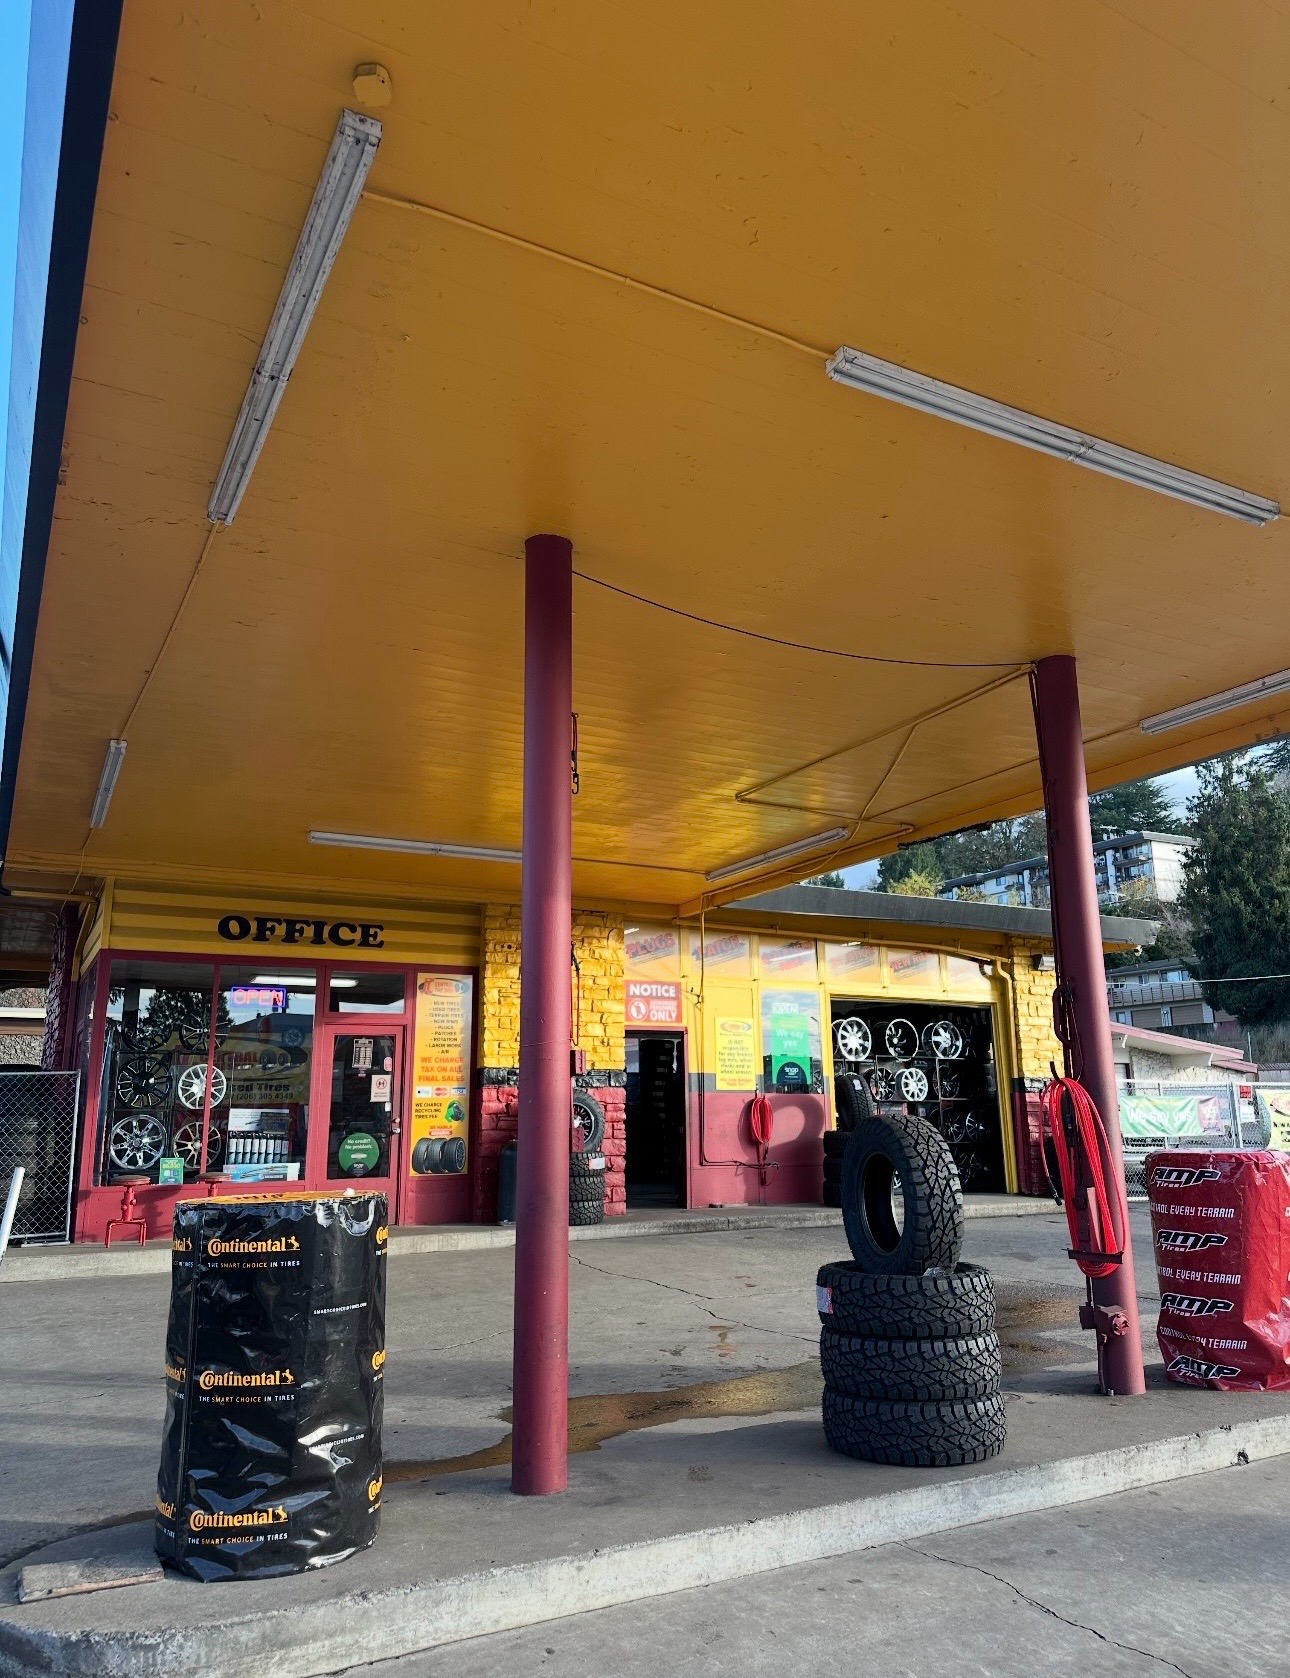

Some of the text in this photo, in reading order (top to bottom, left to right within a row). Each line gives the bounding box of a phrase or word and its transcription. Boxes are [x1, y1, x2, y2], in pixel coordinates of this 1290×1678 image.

[217, 915, 385, 948] OFFICE
[625, 932, 676, 960] PLUGS
[629, 983, 676, 997] NOTICE
[234, 989, 283, 1006] OPEN
[650, 1010, 677, 1021] ONLY
[773, 1004, 798, 1014] OPEN
[776, 1029, 789, 1038] We
[783, 1040, 798, 1049] yes
[256, 1082, 290, 1092] Tires
[236, 1092, 257, 1101] (206)
[259, 1092, 272, 1100] 305
[277, 1092, 294, 1100] 4349
[1169, 1204, 1196, 1216] EVERY
[1197, 1207, 1235, 1219] TERRAIN
[207, 1236, 286, 1257] Continental
[1175, 1269, 1202, 1281] EVERY
[1203, 1272, 1241, 1285] TERRAIN
[1208, 1338, 1248, 1350] TERRAIN
[199, 1369, 281, 1390] Continental
[211, 1395, 234, 1403] SMART
[274, 1394, 295, 1402] TIRES
[189, 1507, 274, 1531] Continental
[201, 1537, 224, 1545] SMART
[226, 1536, 254, 1544] CHOICE
[267, 1532, 288, 1541] TIRES
